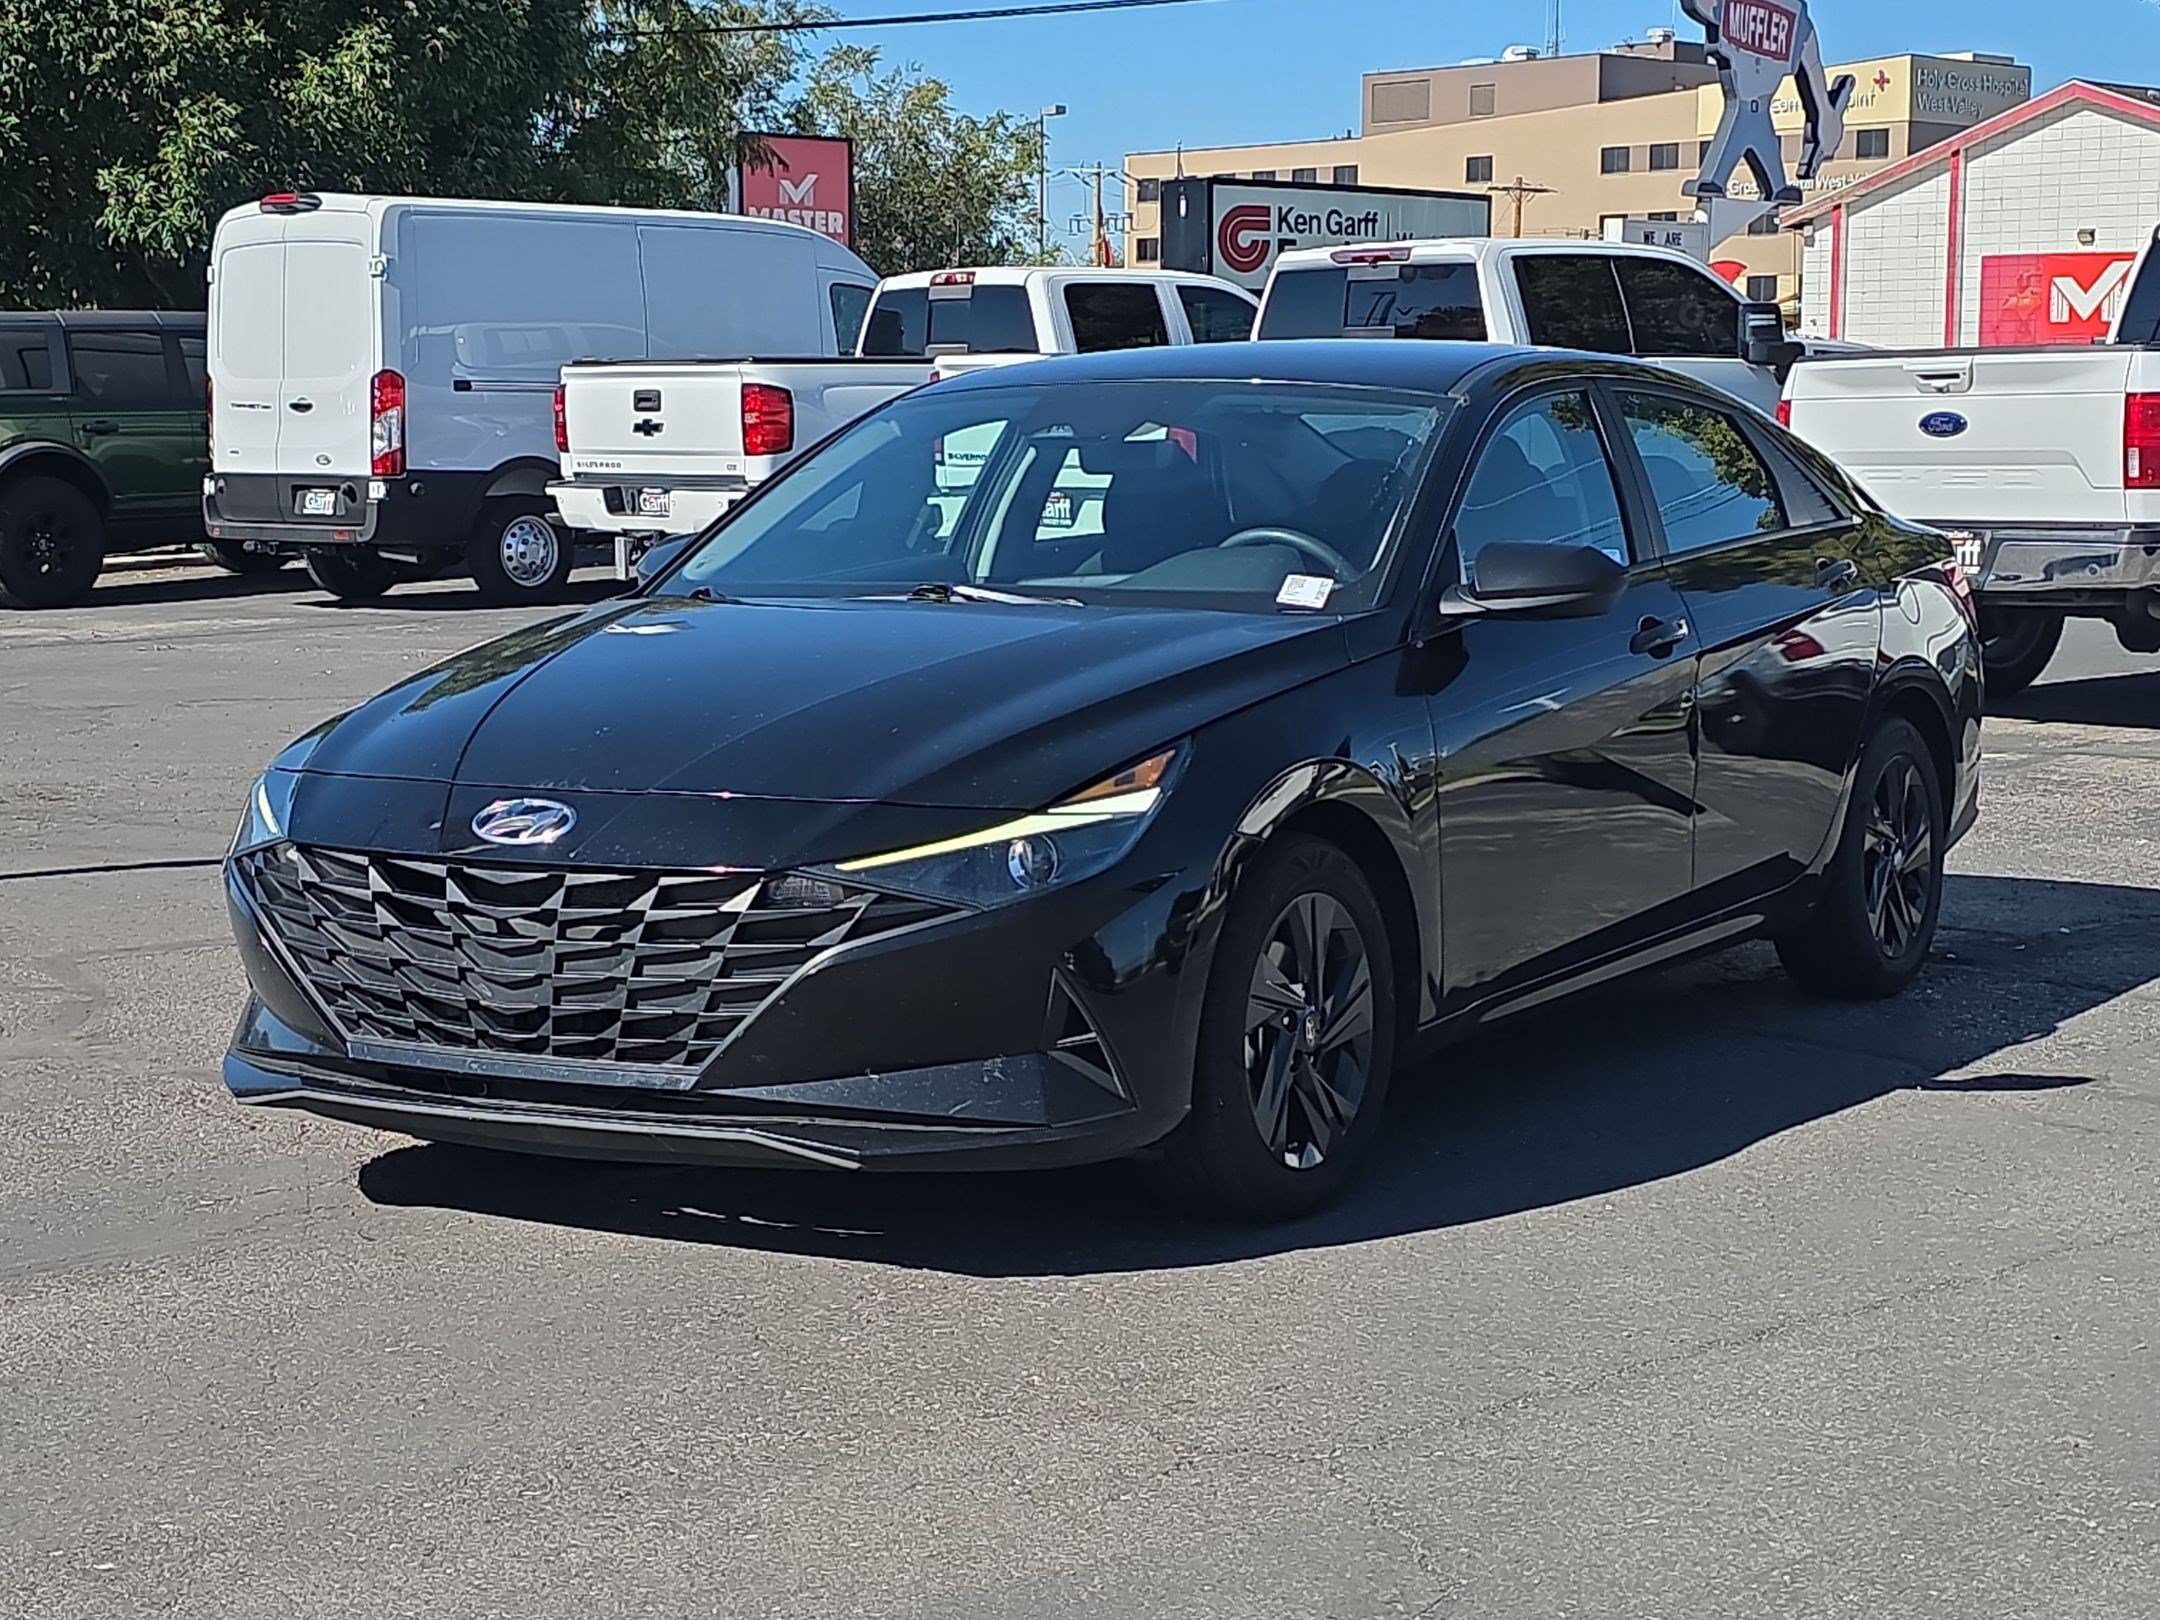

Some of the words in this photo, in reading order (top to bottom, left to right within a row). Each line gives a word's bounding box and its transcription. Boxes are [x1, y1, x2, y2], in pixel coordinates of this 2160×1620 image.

[1729, 2, 1789, 55] MUFFLER
[1917, 68, 1945, 91] Holy
[1983, 74, 2028, 97] Hospital
[1917, 92, 1948, 112] West
[1950, 96, 1983, 119] Valley
[748, 206, 844, 234] MASTER
[1277, 206, 1321, 235] Ken
[1326, 208, 1378, 238] Garff
[1643, 231, 1656, 245] WE
[1664, 231, 1683, 246] ARE
